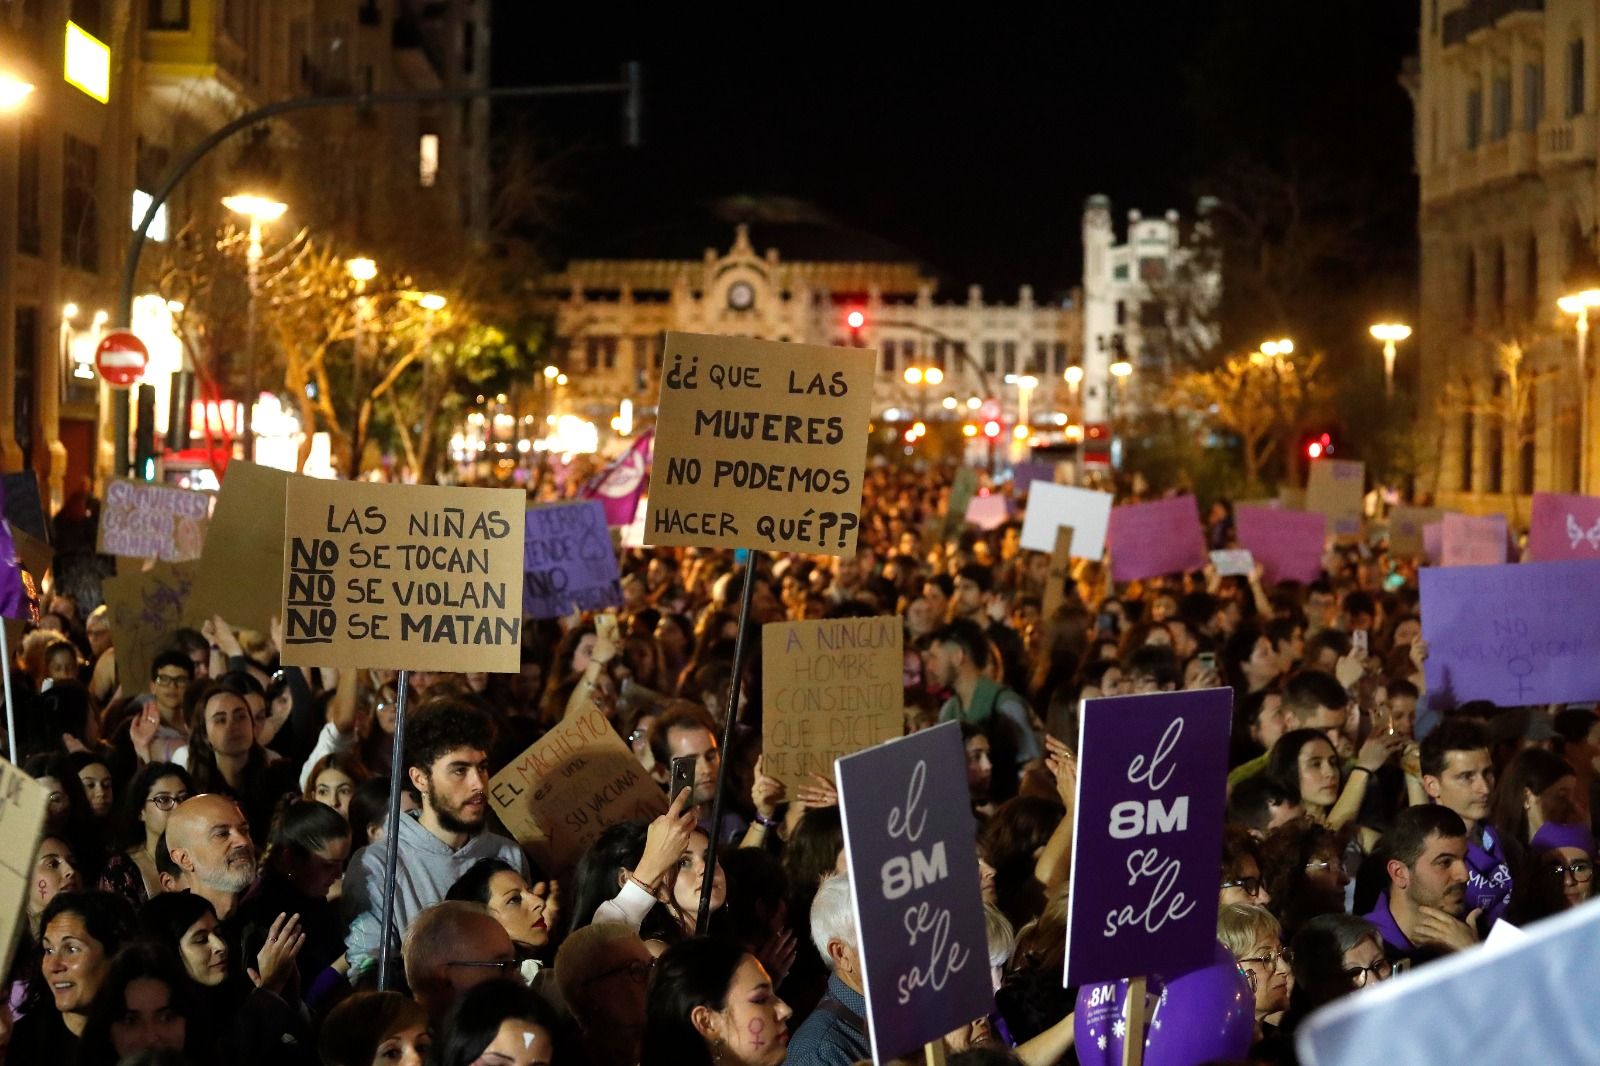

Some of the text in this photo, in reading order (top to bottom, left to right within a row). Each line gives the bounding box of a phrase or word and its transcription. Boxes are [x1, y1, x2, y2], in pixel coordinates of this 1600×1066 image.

[788, 370, 848, 397] LAS
[694, 410, 844, 445] MUJERES
[666, 457, 850, 495] NO PODEMOS
[327, 505, 387, 535] LAS
[409, 508, 511, 539] NIÑAS
[655, 508, 738, 536] HACER
[291, 538, 488, 574] NO SE TOCAN
[288, 574, 336, 605] NO
[347, 578, 385, 604] SE
[392, 580, 506, 609] VIOLAN
[526, 566, 569, 598] NO
[287, 609, 520, 645] NO SE MATAN
[786, 627, 803, 654] A
[794, 652, 880, 682] HOMBRE
[775, 680, 895, 714] CONSIENTO
[771, 719, 813, 748] QUE
[1127, 717, 1184, 790] el
[491, 782, 524, 808] EL
[566, 797, 589, 833] SU
[589, 768, 640, 814] VACUNA
[887, 760, 927, 842] el
[1108, 796, 1189, 839] 8M
[881, 840, 948, 900] 8M
[1126, 848, 1170, 886] se
[1104, 860, 1196, 937] sale
[904, 901, 940, 946] se
[898, 909, 970, 1004] sale
[1091, 983, 1116, 1007] 8M
